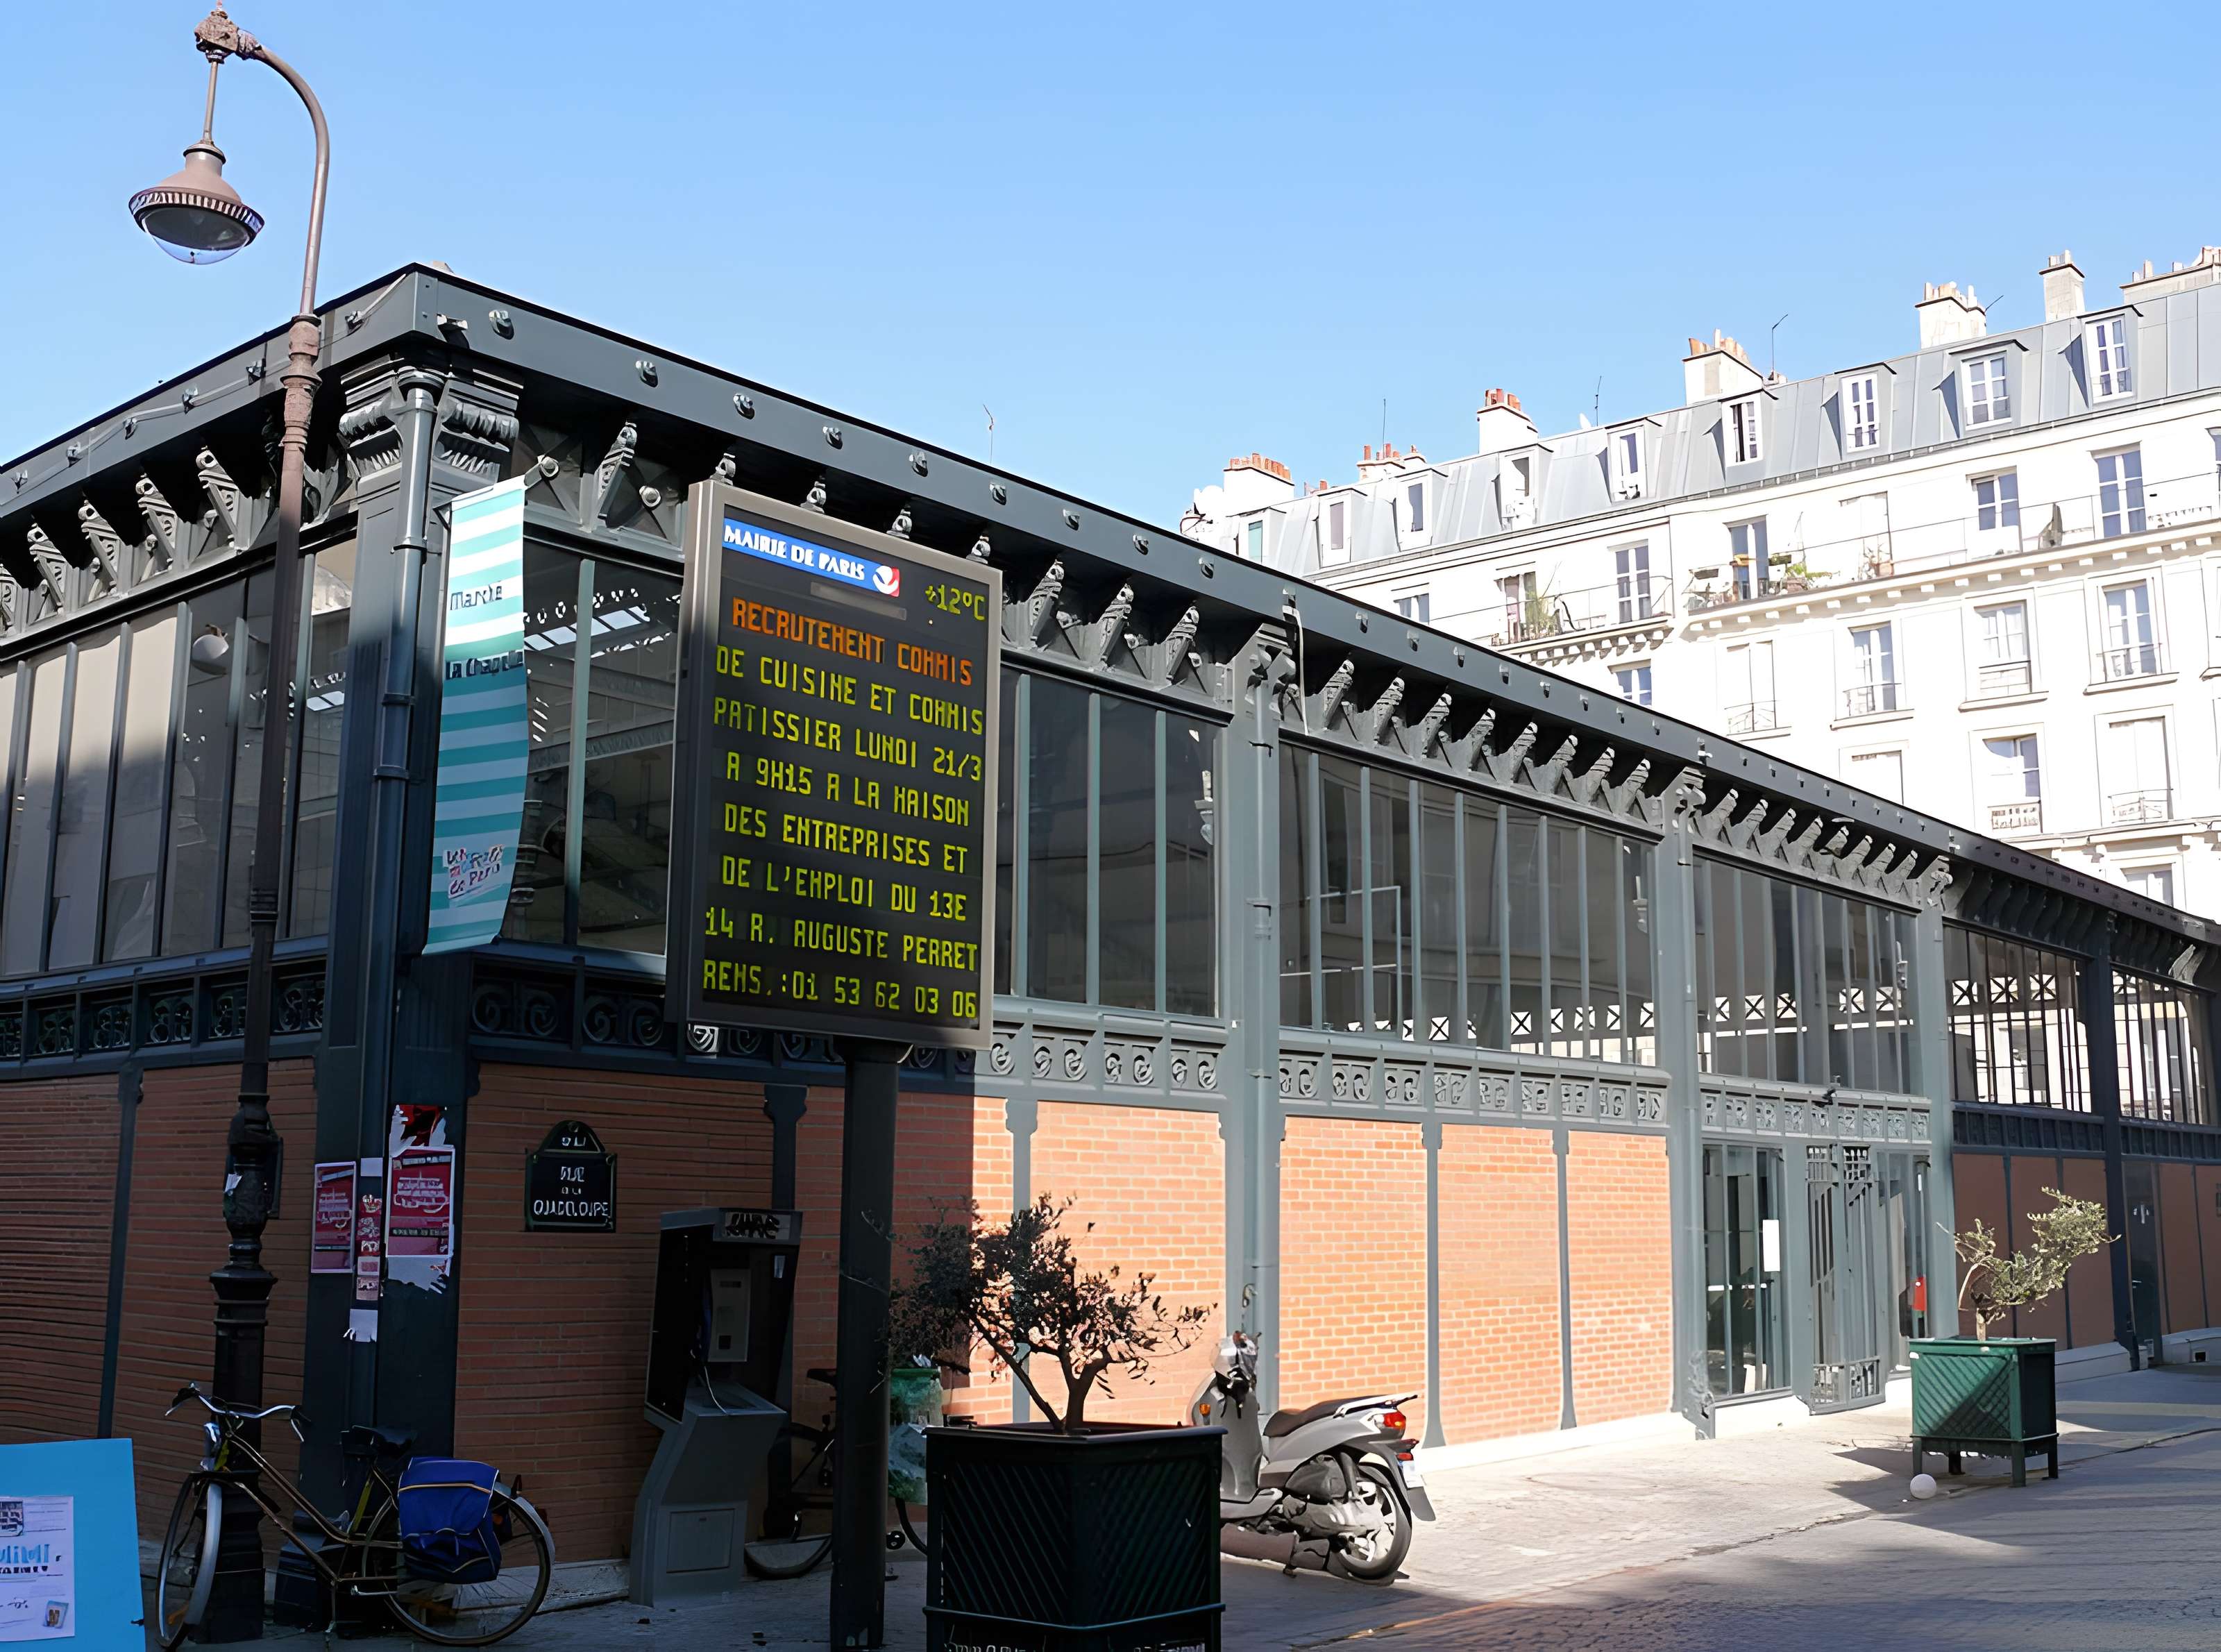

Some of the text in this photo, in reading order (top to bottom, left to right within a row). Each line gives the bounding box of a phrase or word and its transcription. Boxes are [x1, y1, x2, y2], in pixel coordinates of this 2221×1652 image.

[724, 525, 865, 580] MAIRIE DE PARIS
[716, 646, 983, 735] DE CUISINE ET COMMIS
[897, 643, 972, 686] COMMIS
[714, 698, 981, 781] PATISSIER LUNDI 21/3
[727, 752, 969, 827] A 9H15 A LA MAISON
[725, 803, 968, 873] DES ENTREPRISES ET
[723, 856, 967, 921] DE L'EMPLOI DU 13E
[705, 907, 734, 938] 14
[794, 920, 888, 958] AUGUSTE
[903, 935, 978, 971] PERRET
[834, 976, 860, 1005] 53
[876, 981, 900, 1009] 62
[915, 986, 939, 1014] 03
[952, 991, 977, 1018] 06
